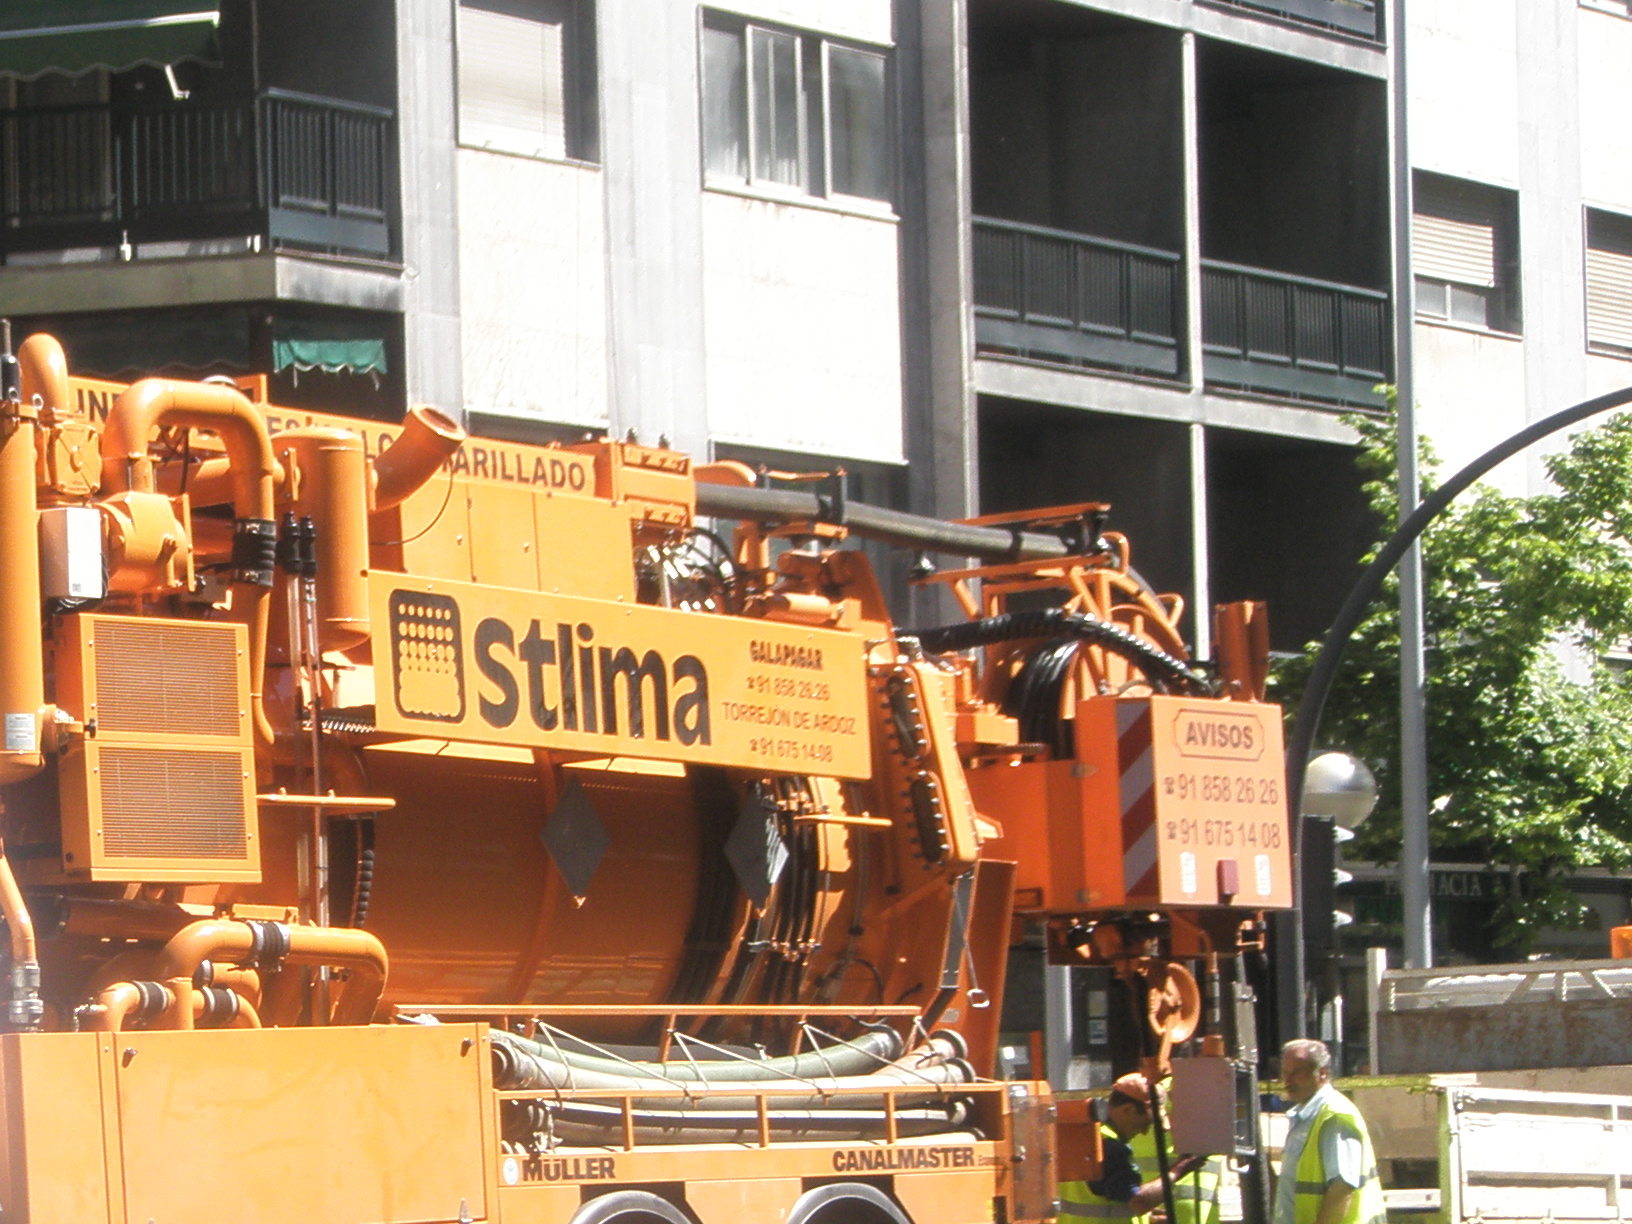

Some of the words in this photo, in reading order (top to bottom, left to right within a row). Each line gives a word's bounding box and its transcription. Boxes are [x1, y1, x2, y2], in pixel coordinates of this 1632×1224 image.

[750, 640, 823, 671] GALAPAGAR
[474, 618, 712, 746] Stlima
[756, 675, 770, 694] 91
[793, 711, 810, 730] DE
[814, 714, 856, 735] ARDOZ
[1186, 721, 1254, 749] AVISOS
[760, 738, 774, 756] 91
[777, 740, 799, 759] 675
[1178, 773, 1197, 799] 91
[1202, 774, 1231, 801] 858
[1235, 777, 1255, 804] 26
[1259, 778, 1278, 805] 26
[1179, 818, 1198, 845] 91
[1204, 819, 1233, 846] 675
[1238, 821, 1257, 847] 14
[1261, 822, 1281, 849] 08
[522, 1157, 615, 1182] MÜLLER
[833, 1147, 974, 1172] CANALMASTER
